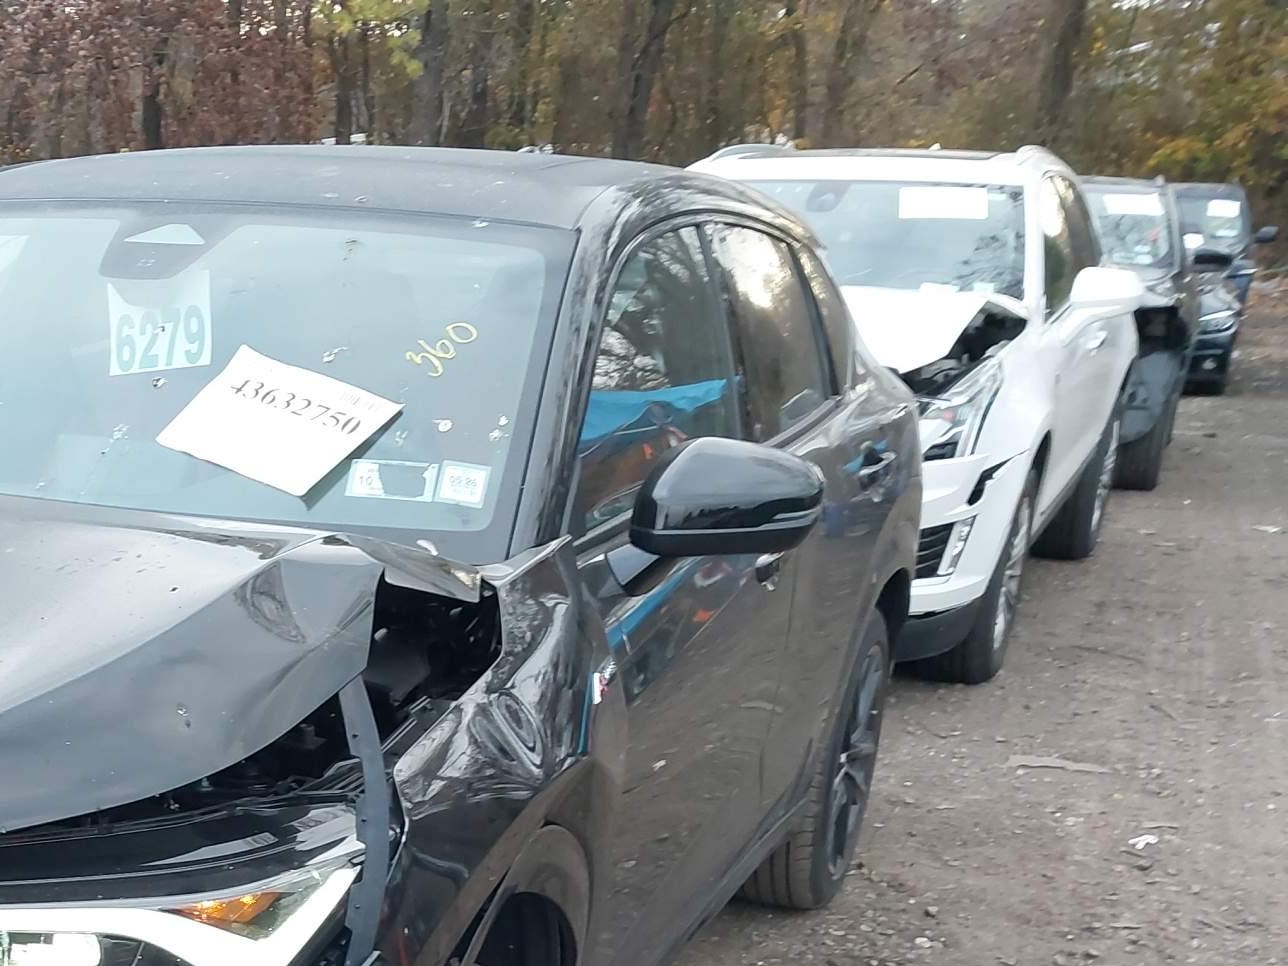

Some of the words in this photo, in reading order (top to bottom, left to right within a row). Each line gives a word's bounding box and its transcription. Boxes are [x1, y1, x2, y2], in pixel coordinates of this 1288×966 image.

[115, 304, 206, 373] 6279
[405, 321, 478, 378] 360
[229, 378, 362, 435] 43632750
